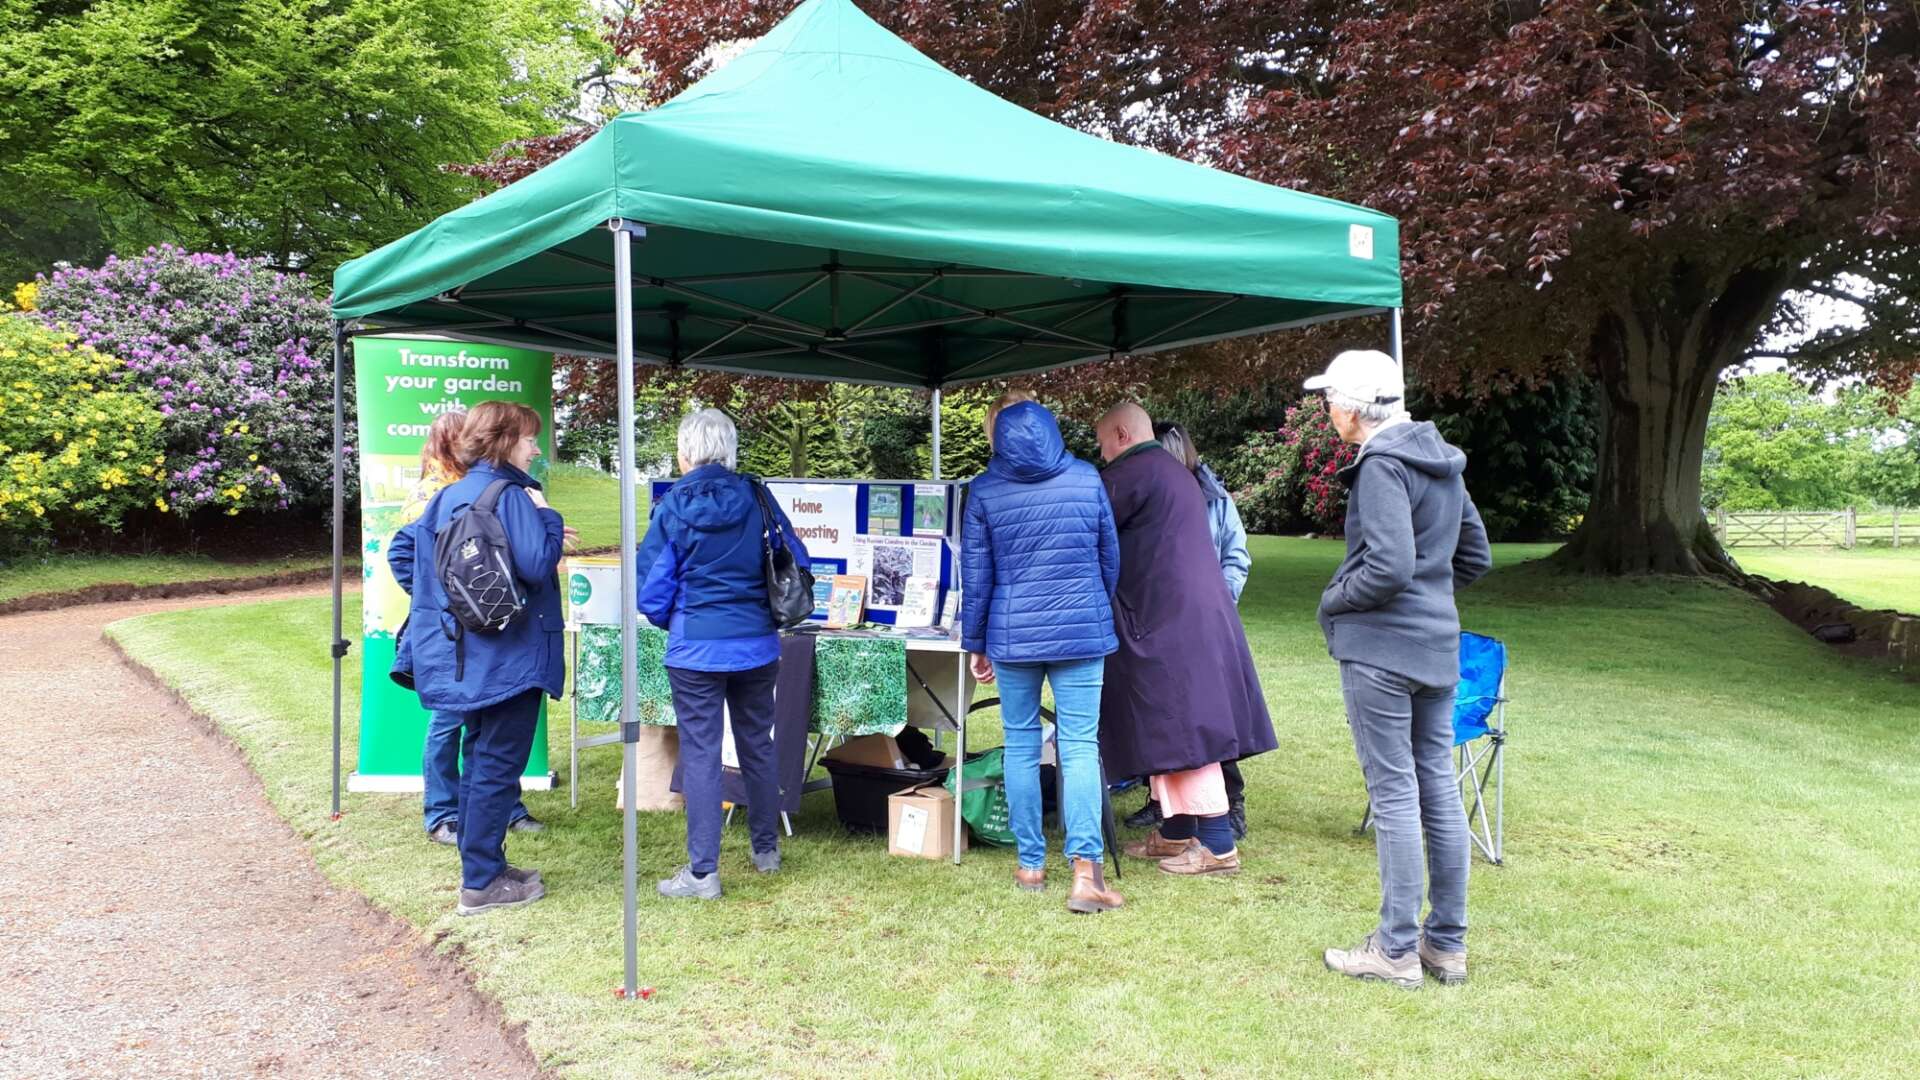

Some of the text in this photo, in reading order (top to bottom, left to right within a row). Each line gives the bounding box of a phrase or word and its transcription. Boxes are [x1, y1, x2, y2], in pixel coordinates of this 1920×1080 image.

[399, 349, 509, 370] Transform
[385, 374, 523, 394] your garden
[420, 398, 467, 414] with
[387, 423, 432, 436] com
[792, 497, 823, 514] Home
